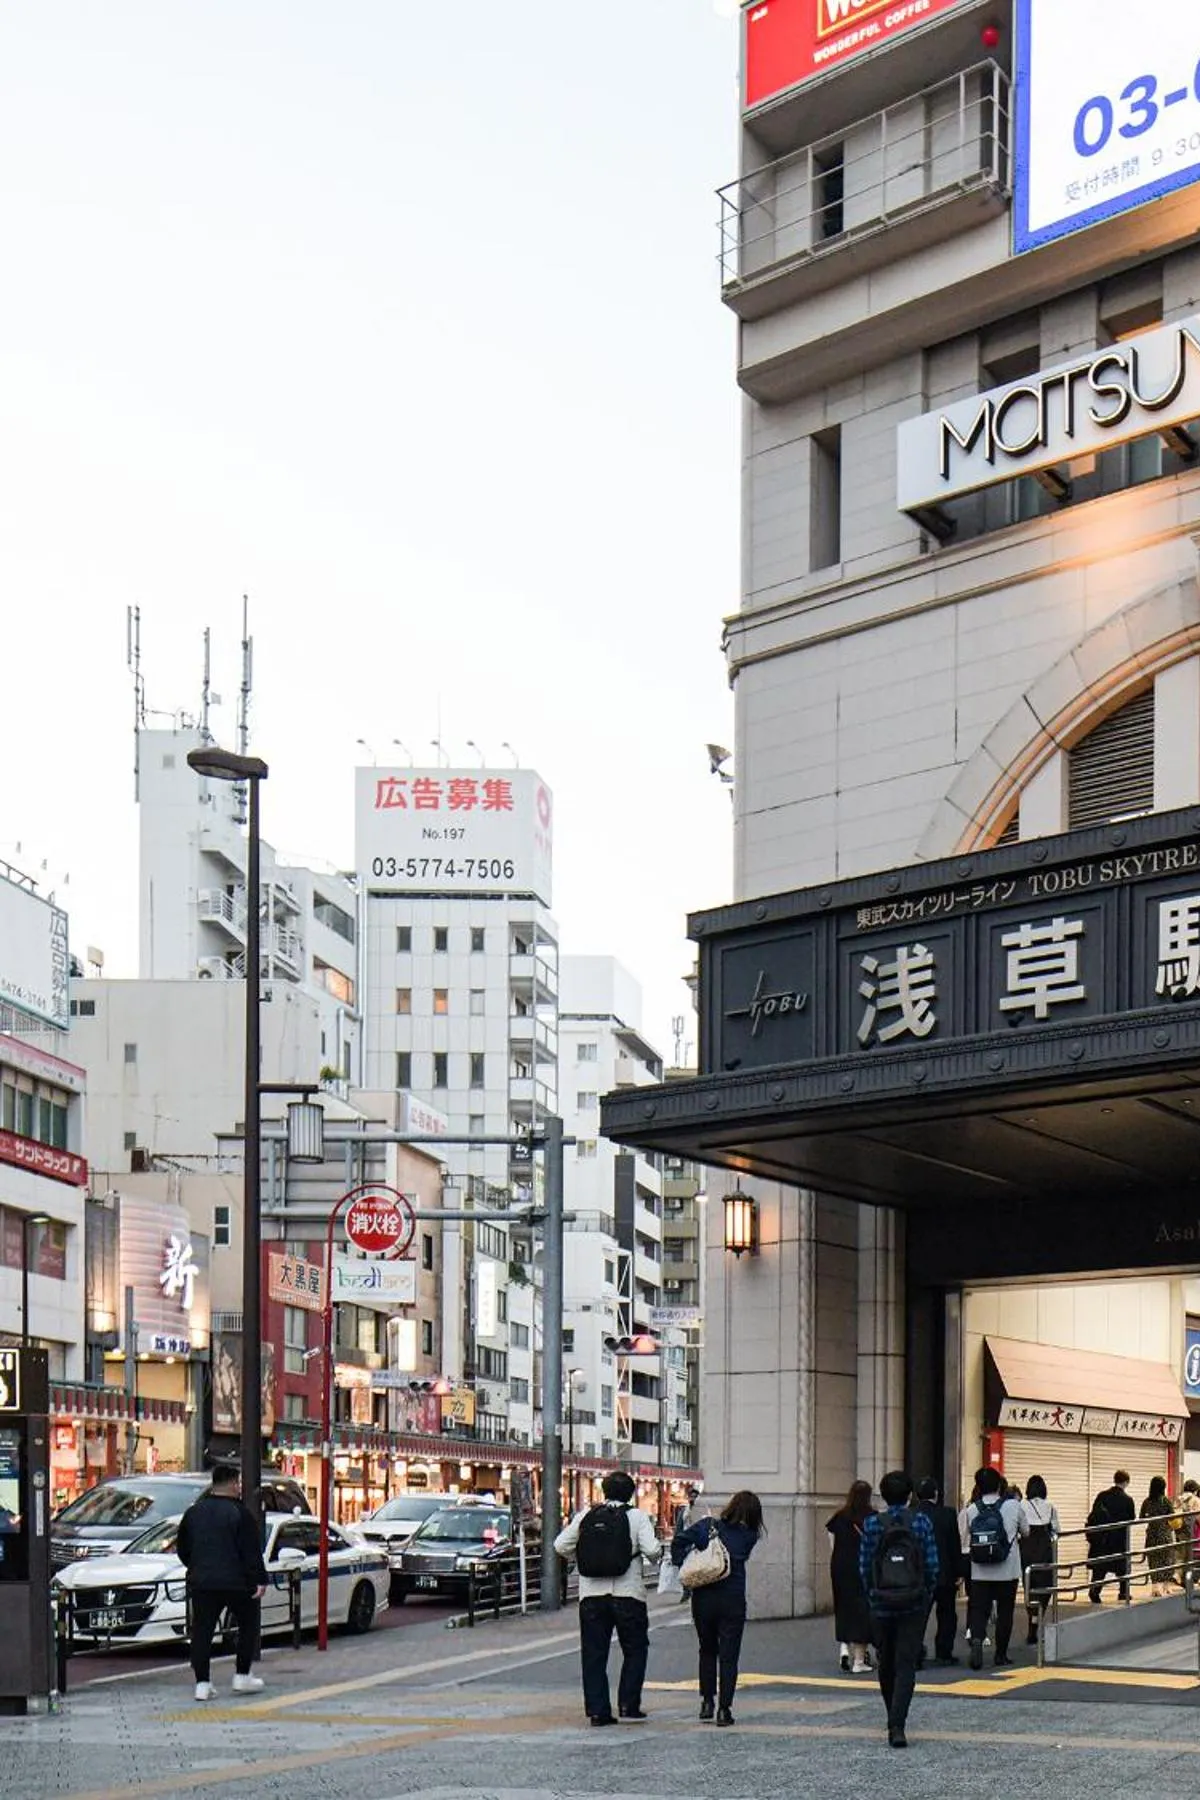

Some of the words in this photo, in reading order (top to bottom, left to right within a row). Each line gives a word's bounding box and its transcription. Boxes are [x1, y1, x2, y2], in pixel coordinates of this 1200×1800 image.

[812, 23, 882, 63] WONDERFUL
[884, 0, 931, 28] COFFEE
[1063, 156, 1141, 204] 受付時間
[374, 776, 515, 811] 広告募集
[422, 828, 465, 841] No.197
[371, 857, 515, 879] 03-5774-7506
[855, 881, 1017, 930] 東武スカイツリーライン
[1028, 863, 1094, 896] TOBU
[351, 1212, 399, 1236] 消火栓
